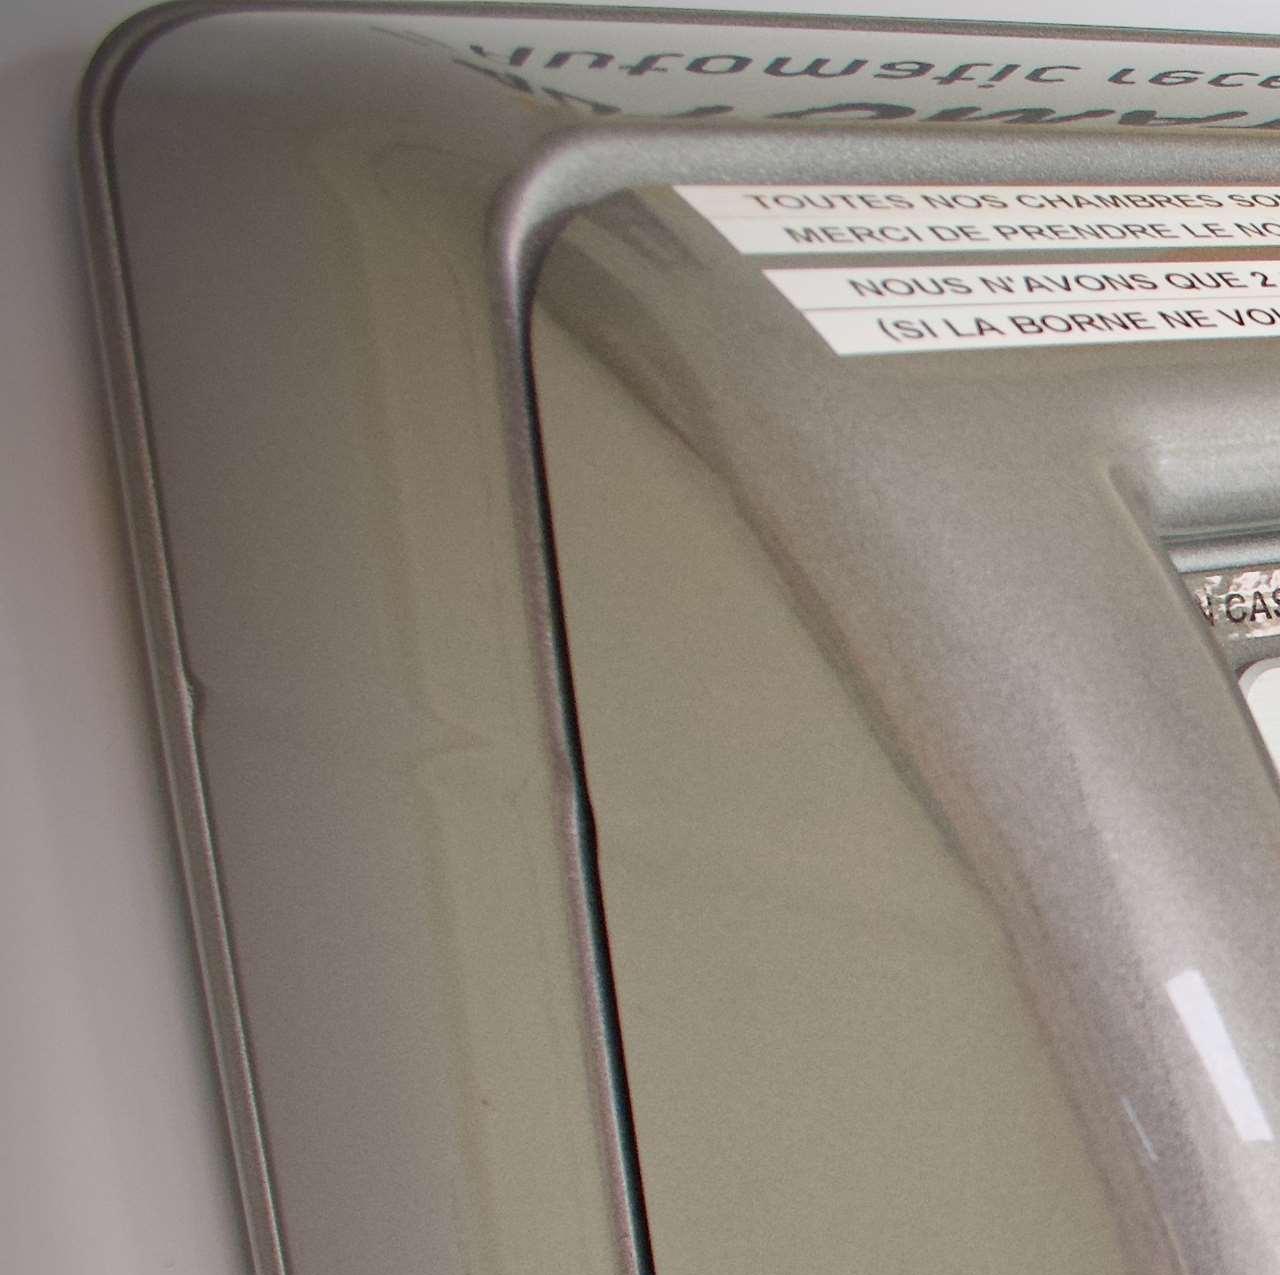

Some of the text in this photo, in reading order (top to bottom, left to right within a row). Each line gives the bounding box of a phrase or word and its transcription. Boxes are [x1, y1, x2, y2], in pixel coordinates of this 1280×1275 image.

[743, 194, 913, 211] TOUTES
[923, 194, 1009, 210] NOS
[1016, 194, 1223, 210] CHAMBRES
[784, 225, 922, 246] MERCI
[930, 225, 990, 244] DE
[994, 223, 1179, 242] PRENDRE
[1181, 222, 1233, 239] LE
[847, 278, 972, 298] NOUS
[980, 274, 1158, 296] N'AVONS
[1165, 271, 1250, 290] QUE
[1250, 271, 1278, 288] 2
[876, 317, 936, 341] (SI
[943, 316, 1000, 337] LA
[1009, 311, 1160, 335] BORNE
[1157, 309, 1217, 331] NE
